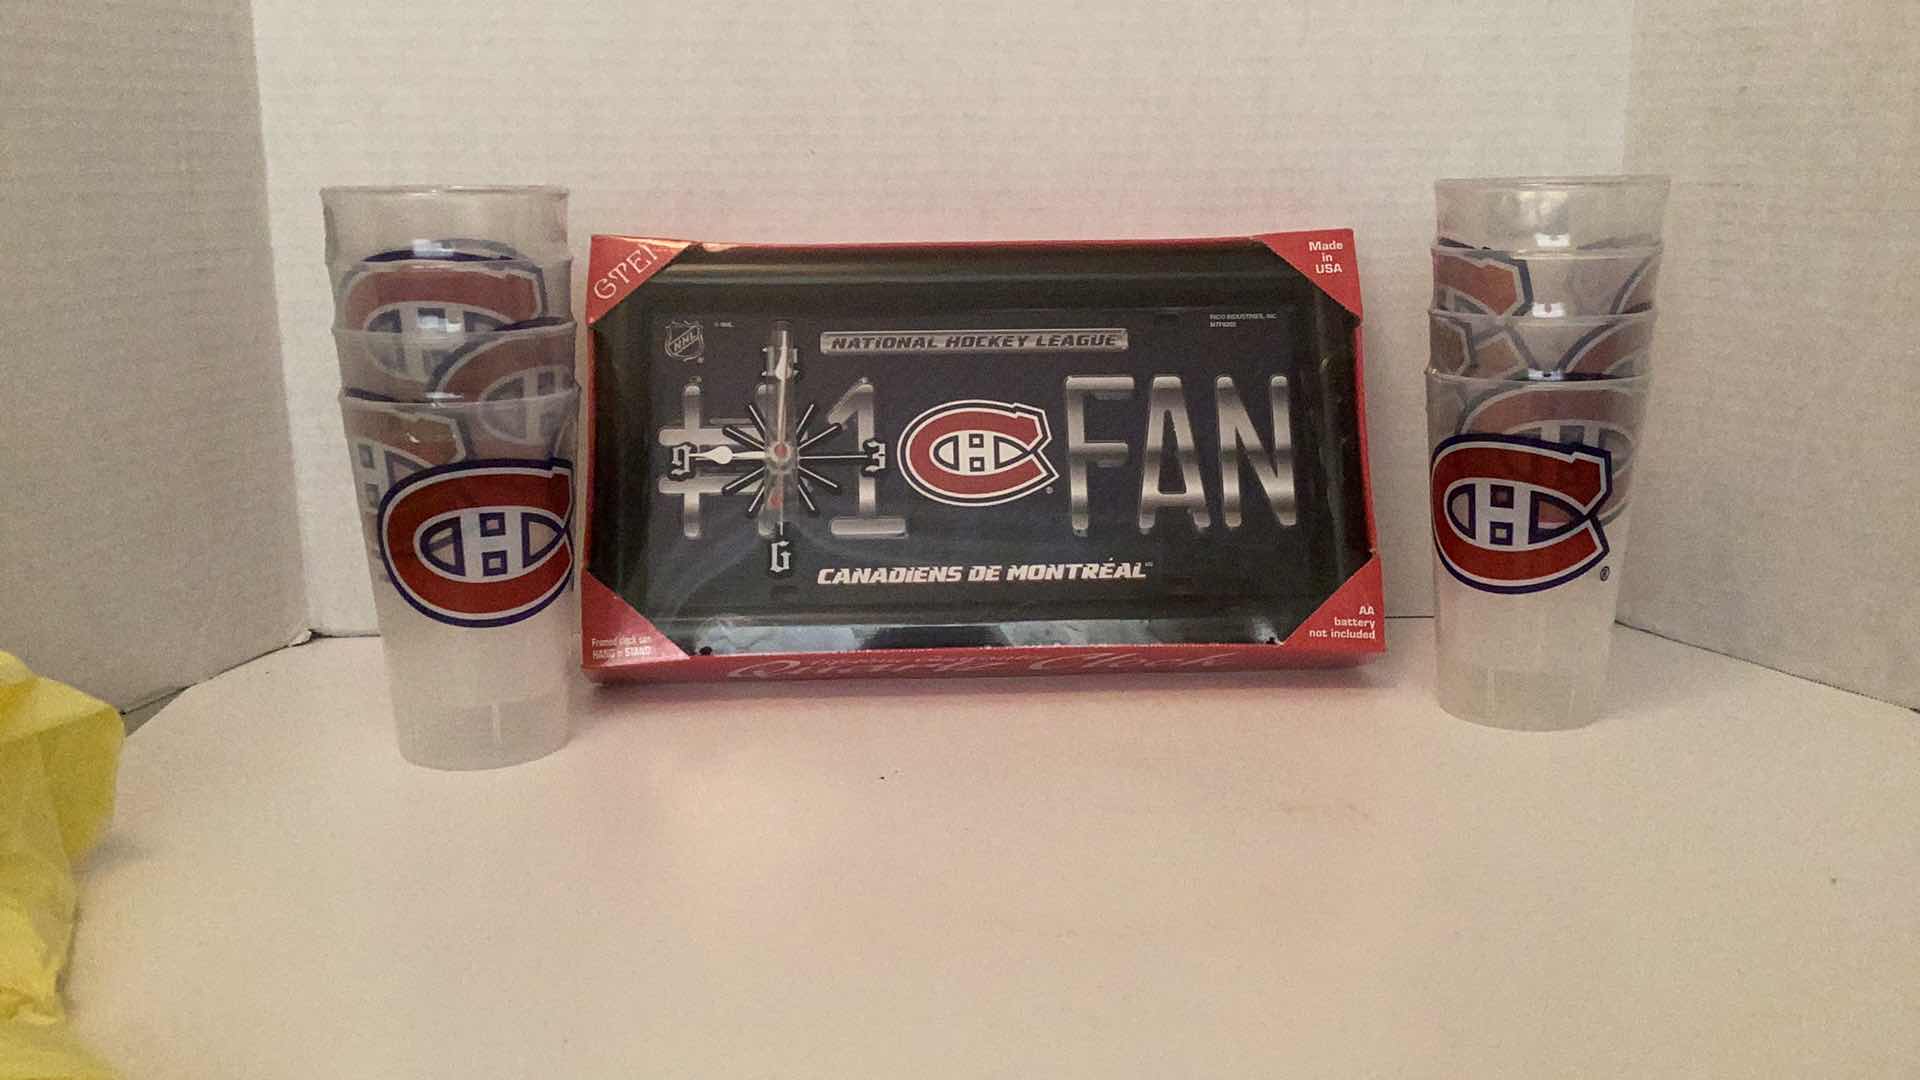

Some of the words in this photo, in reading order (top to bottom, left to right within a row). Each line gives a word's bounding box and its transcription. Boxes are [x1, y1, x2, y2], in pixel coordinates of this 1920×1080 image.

[1308, 240, 1344, 252] Made
[1322, 252, 1333, 262] in
[1315, 263, 1343, 274] USA
[673, 331, 699, 353] NHL
[831, 335, 938, 350] NATIONAL
[945, 334, 1028, 349] HOCKEY
[1035, 333, 1118, 347] LEAGUE
[1065, 375, 1297, 536] FAN
[817, 564, 963, 585] CANADIENS
[968, 564, 1002, 582] DE
[1006, 558, 1147, 582] MONTRÉAL
[1359, 605, 1375, 616] AA
[1334, 616, 1376, 629] battery
[1309, 629, 1328, 638] not
[1331, 628, 1376, 640] included
